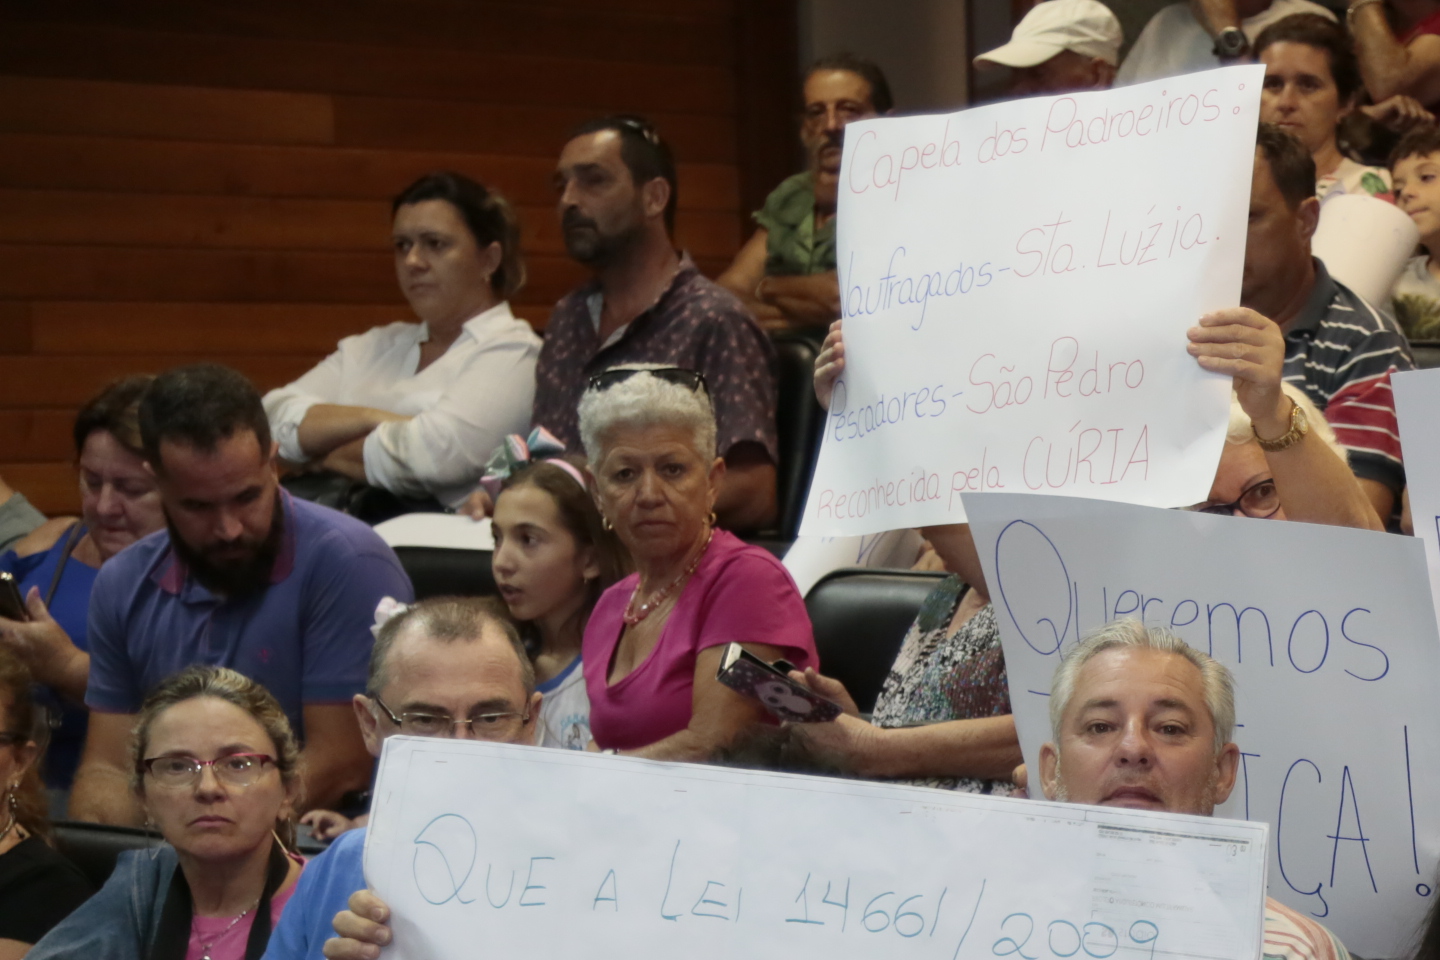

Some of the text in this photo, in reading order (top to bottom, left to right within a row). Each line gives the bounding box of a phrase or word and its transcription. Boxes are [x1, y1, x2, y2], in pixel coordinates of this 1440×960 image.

[847, 119, 962, 202] Capela
[977, 121, 1029, 164] dos
[1043, 335, 1145, 400] Pedro
[816, 419, 1150, 521] Reconhecida pela CÚRIA
[411, 811, 556, 911] QUE
[591, 867, 620, 913] A
[659, 838, 744, 924] LEI
